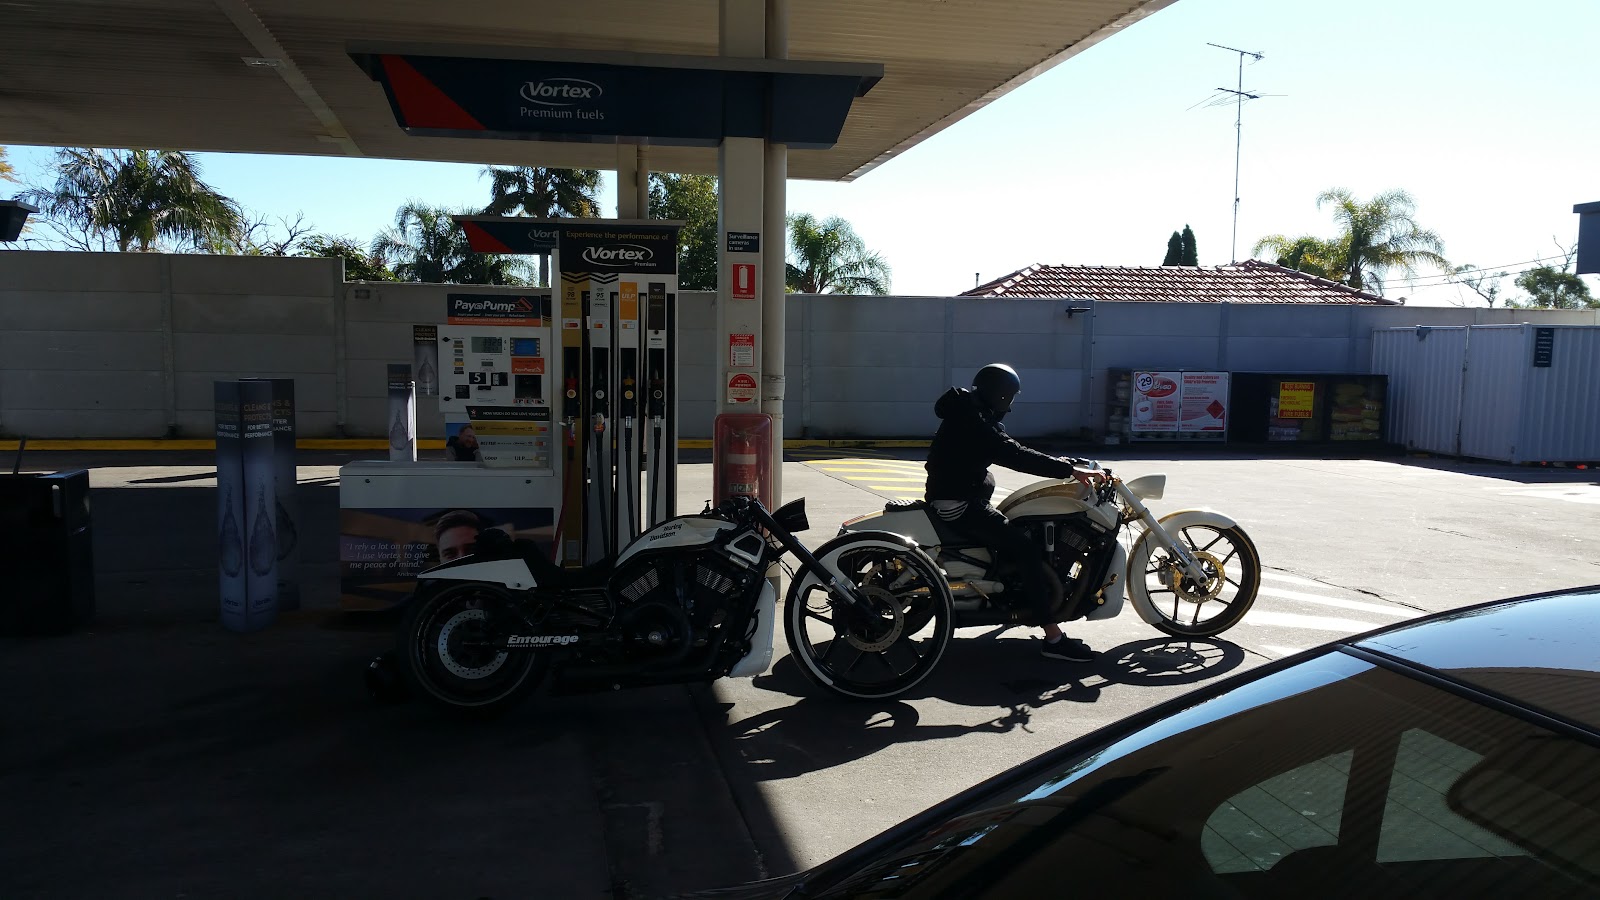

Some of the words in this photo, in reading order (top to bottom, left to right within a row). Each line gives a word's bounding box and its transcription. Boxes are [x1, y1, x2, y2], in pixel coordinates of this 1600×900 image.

[524, 80, 593, 99] Vortex
[520, 106, 573, 119] Premium
[576, 108, 605, 120] fuels
[566, 231, 602, 239] Experience
[605, 231, 616, 239] the
[617, 232, 660, 241] performance
[661, 232, 669, 240] of
[586, 246, 646, 261] Vortex
[474, 372, 482, 383] 5
[244, 430, 272, 439] PERFORMANCE
[355, 543, 369, 552] rely
[378, 542, 389, 550] lot
[402, 544, 415, 552] my
[414, 552, 430, 561] give
[364, 562, 388, 571] peace
[507, 634, 579, 646] Entourage
